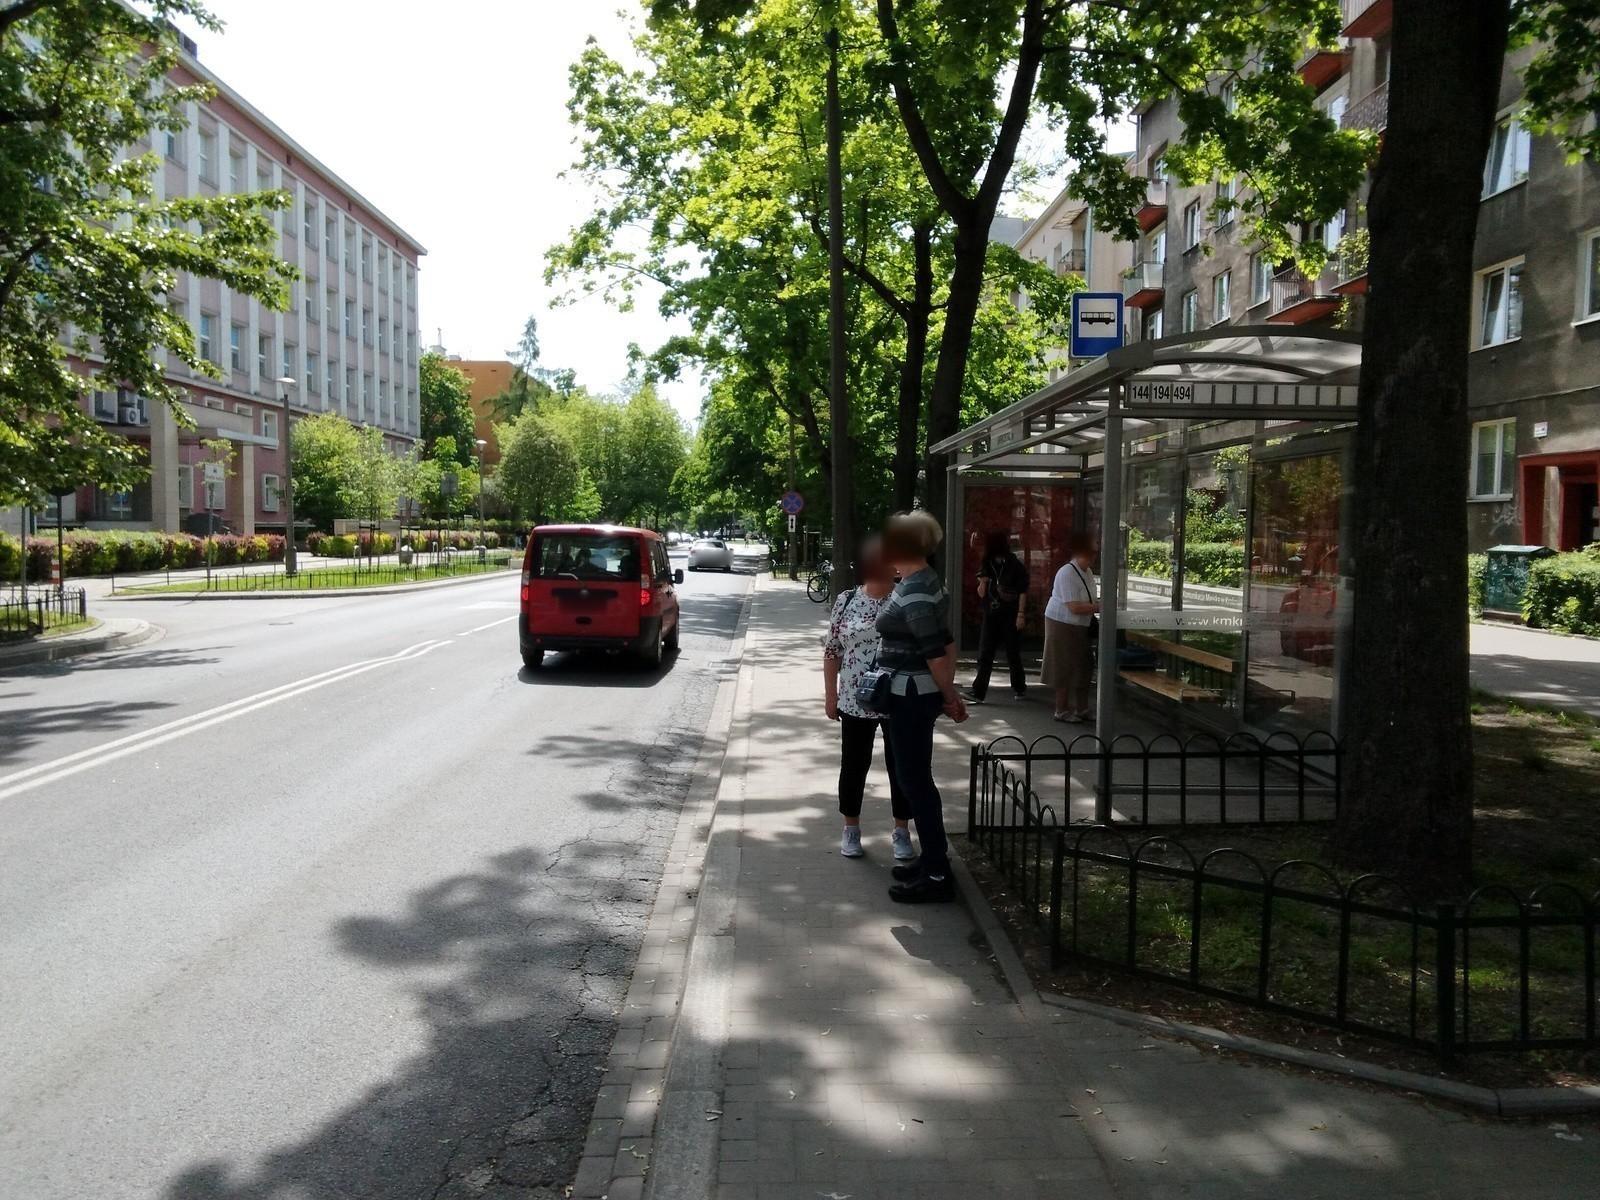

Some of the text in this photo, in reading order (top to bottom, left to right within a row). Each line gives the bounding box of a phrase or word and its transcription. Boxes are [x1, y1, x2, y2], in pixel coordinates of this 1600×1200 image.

[1132, 385, 1191, 400] 144 194 494
